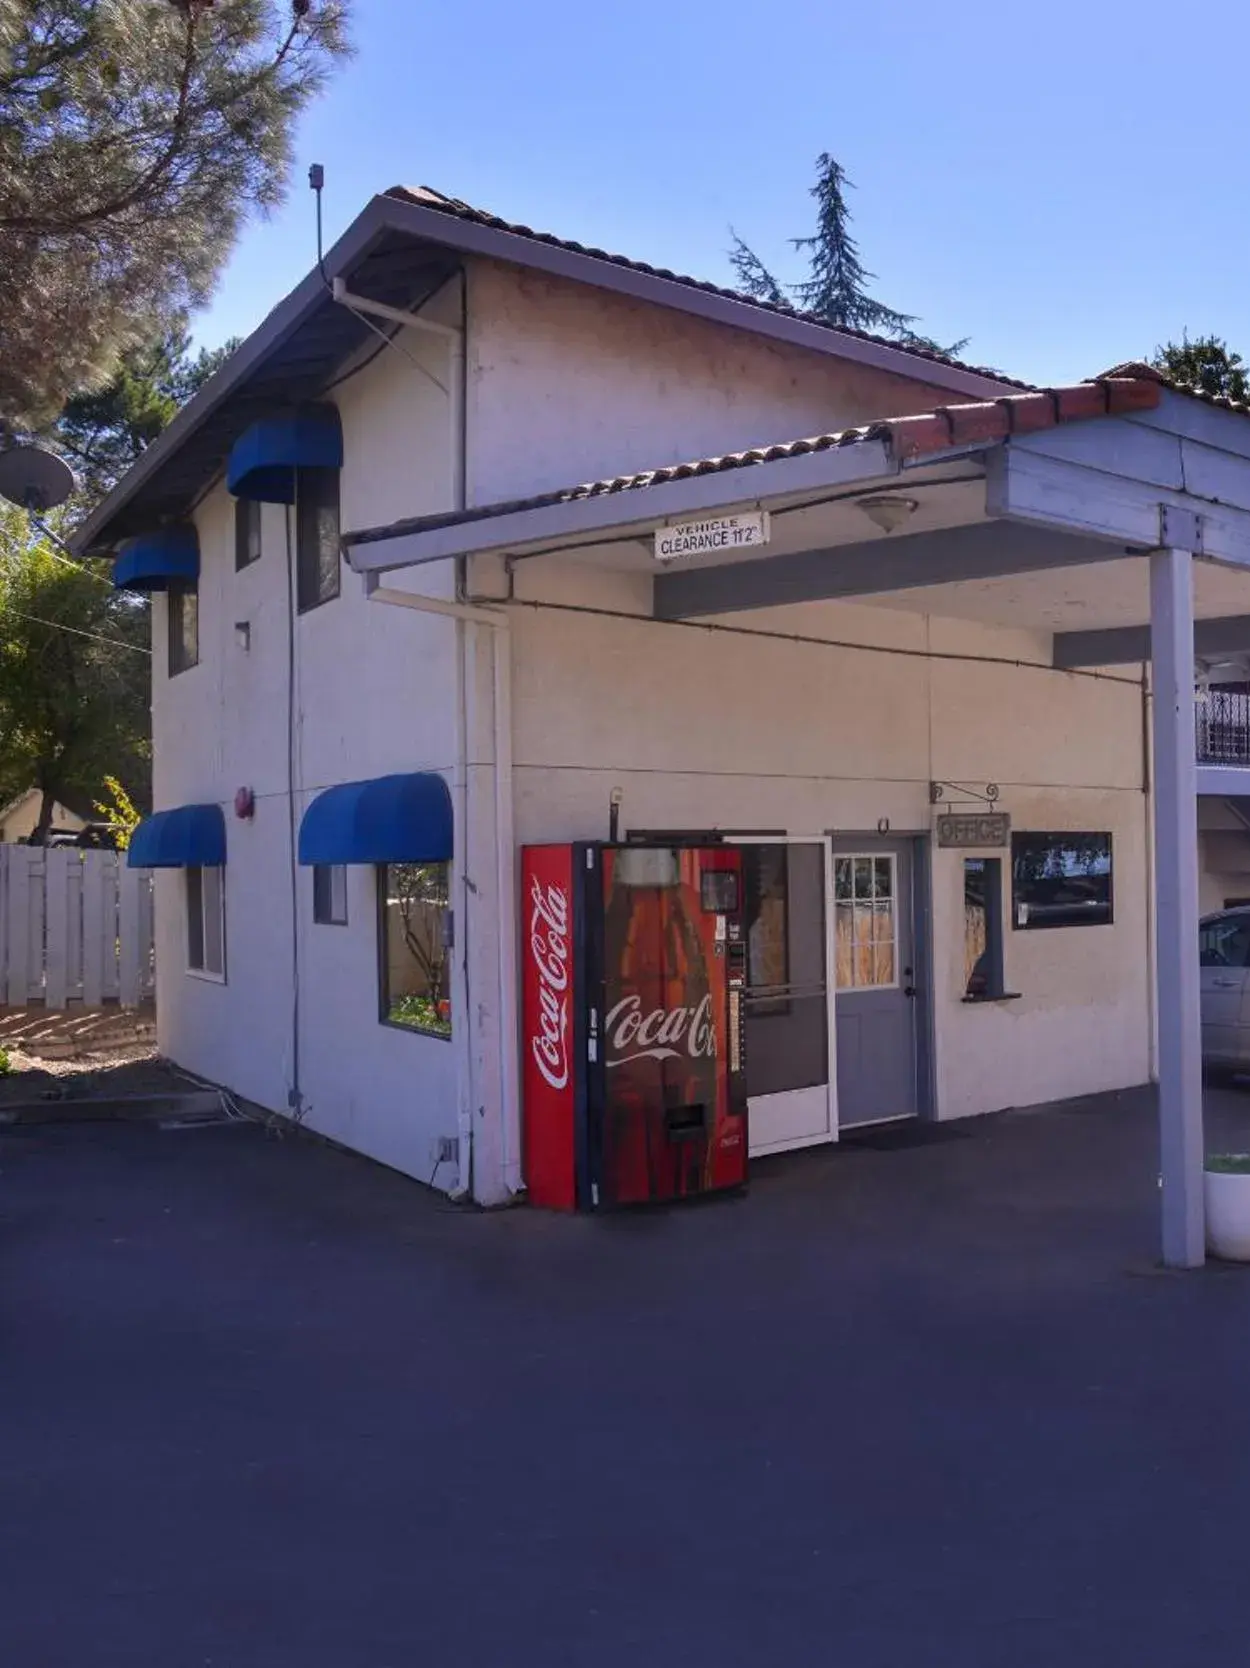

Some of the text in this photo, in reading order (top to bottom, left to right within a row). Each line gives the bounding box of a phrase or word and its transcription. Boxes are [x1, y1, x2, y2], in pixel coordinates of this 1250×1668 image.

[675, 519, 739, 536] VEHICLE
[660, 531, 729, 555] CLEARANCE
[941, 818, 1003, 841] OFFICE
[531, 873, 568, 1089] Coca-Cola
